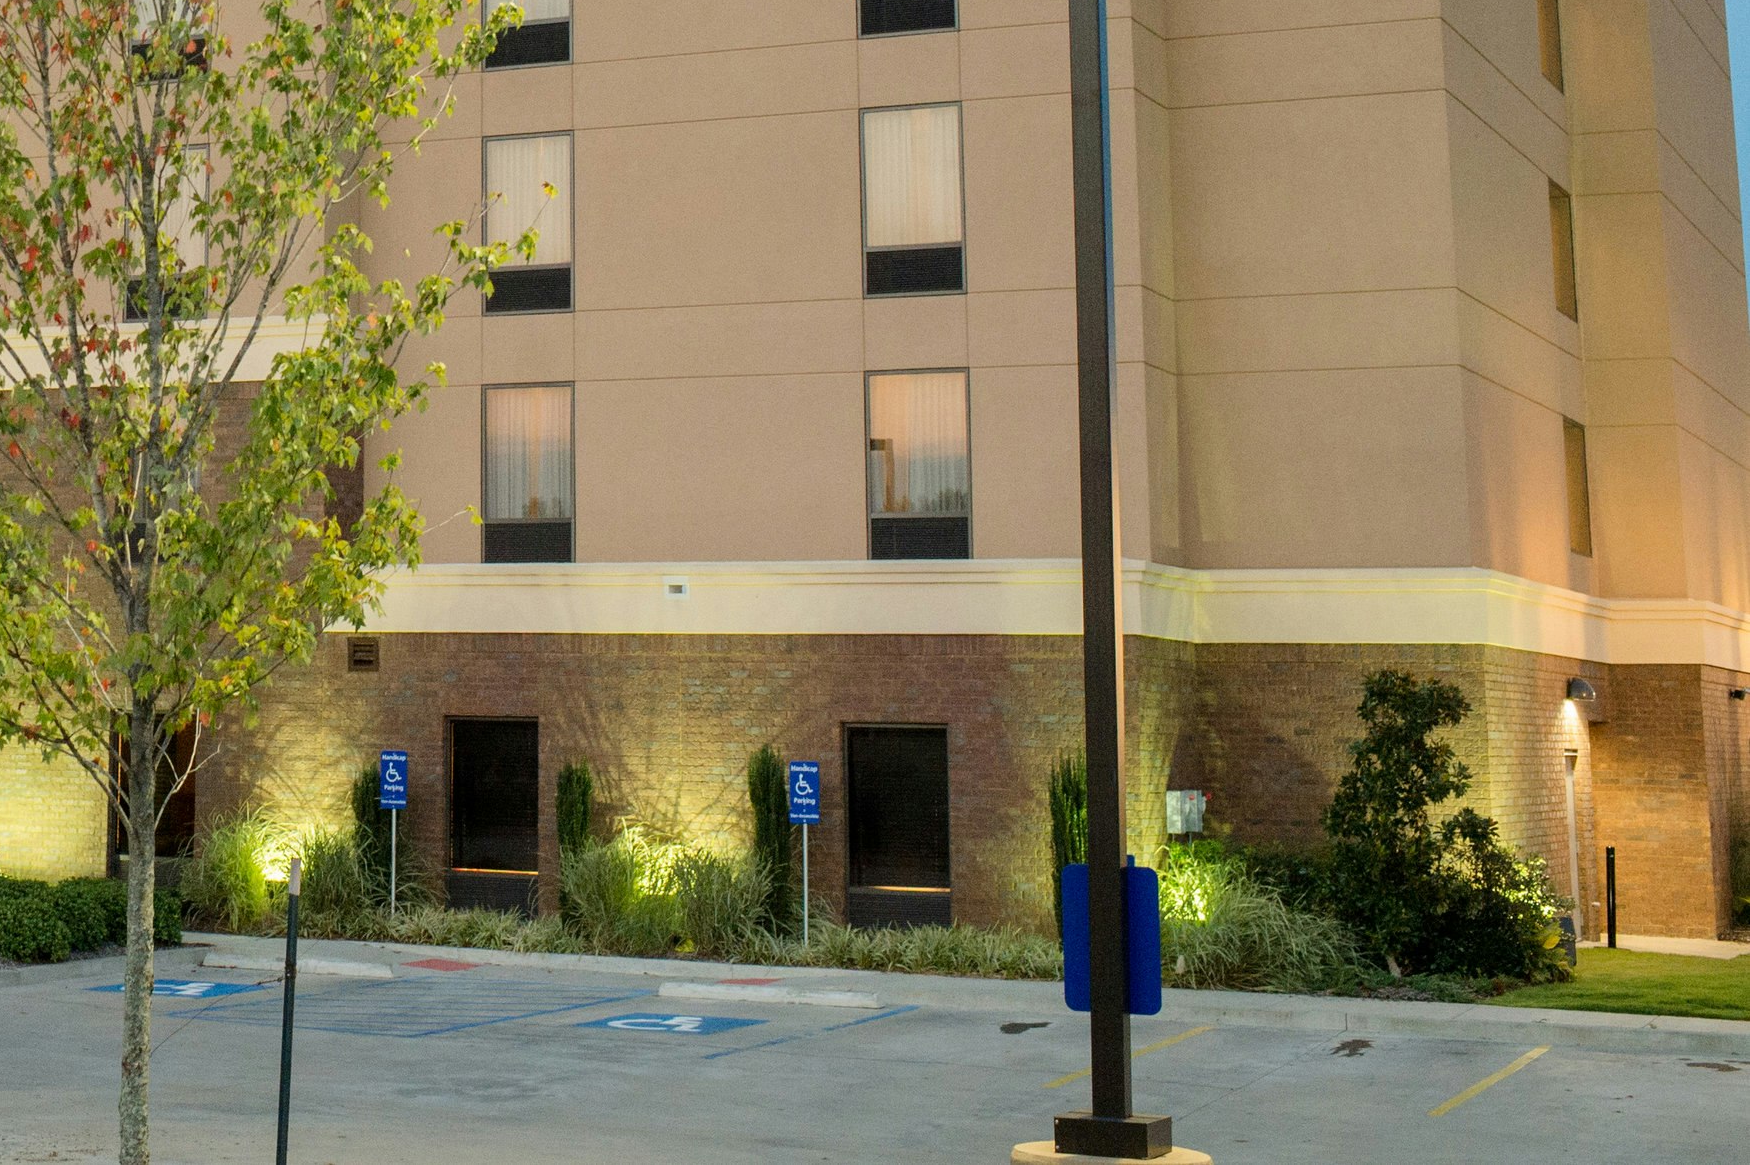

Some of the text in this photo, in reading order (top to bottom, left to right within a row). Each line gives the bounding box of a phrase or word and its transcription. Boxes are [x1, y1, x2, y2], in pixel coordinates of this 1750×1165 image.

[382, 754, 407, 762] Handicap
[790, 765, 818, 773] Handicap
[793, 797, 816, 806] Parking
